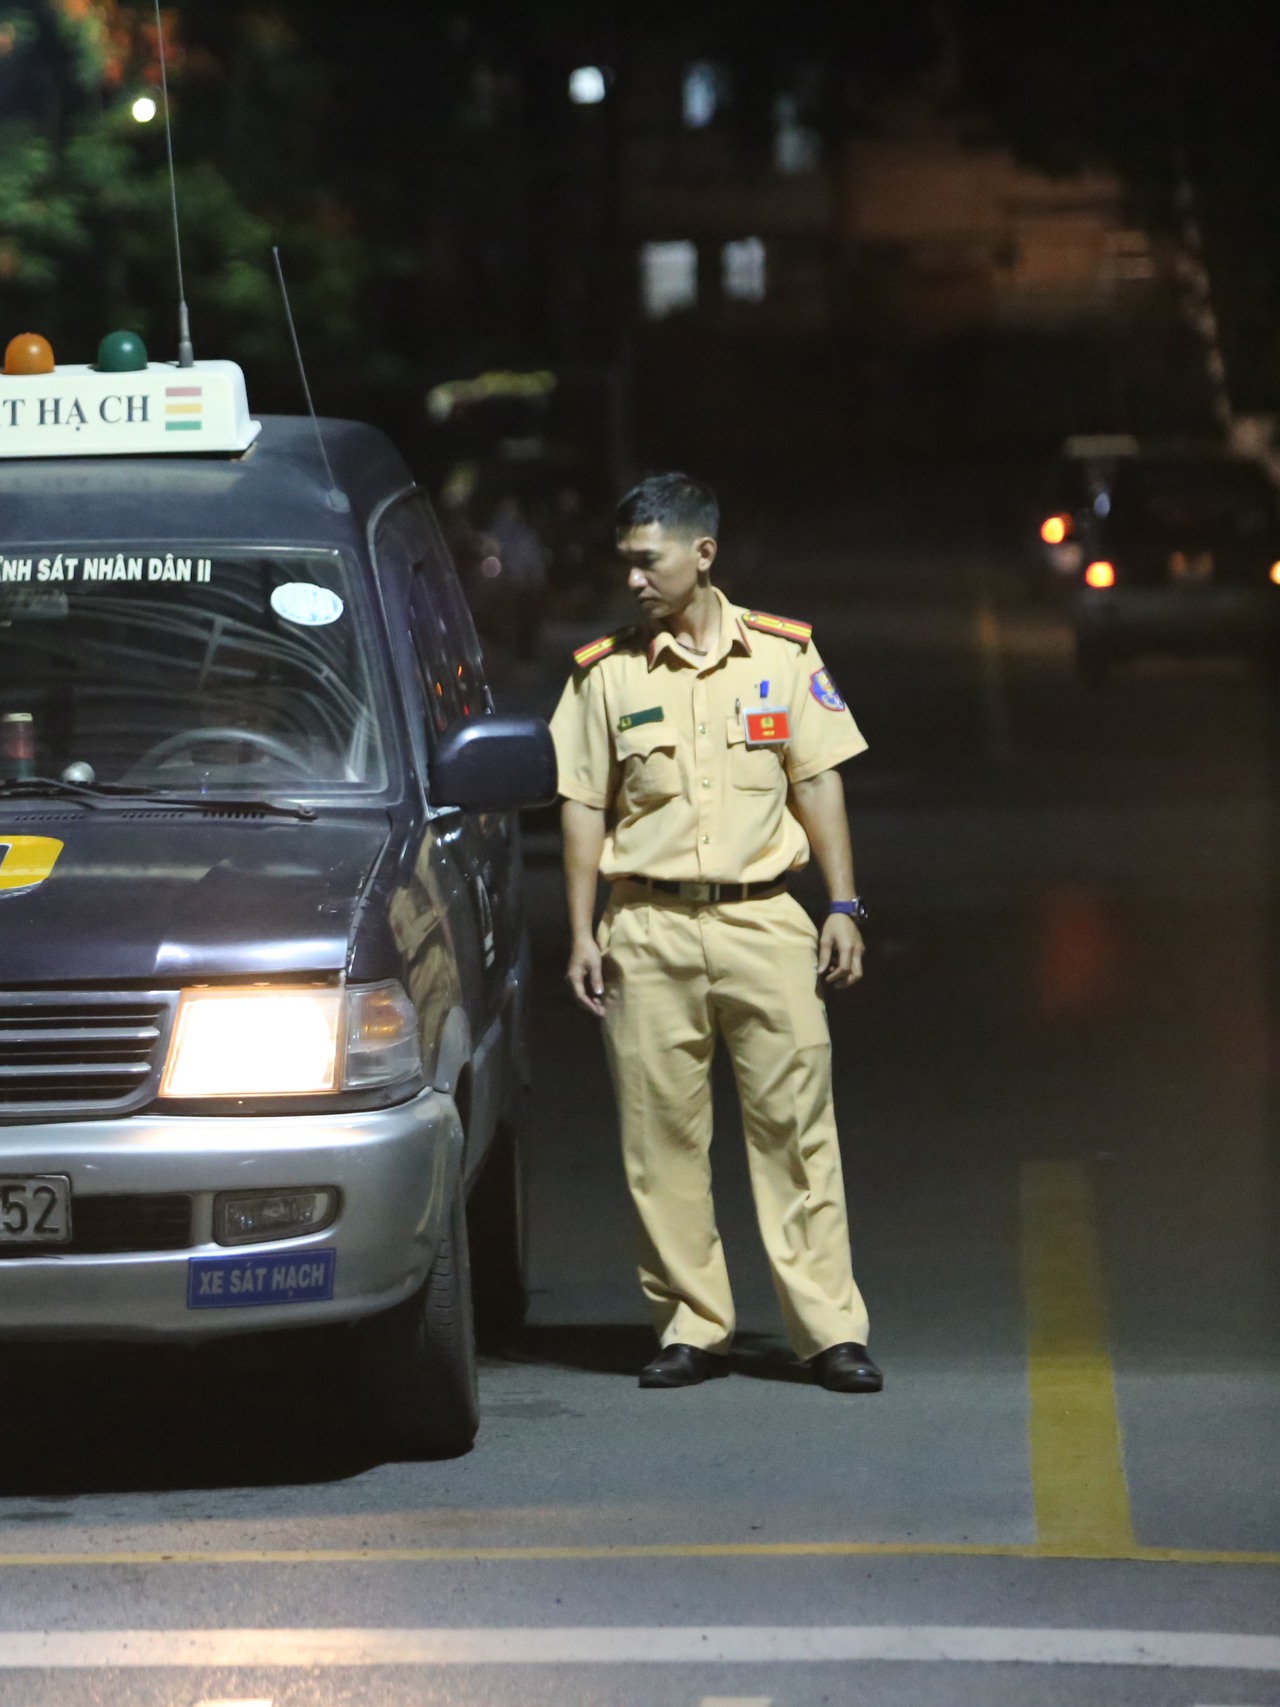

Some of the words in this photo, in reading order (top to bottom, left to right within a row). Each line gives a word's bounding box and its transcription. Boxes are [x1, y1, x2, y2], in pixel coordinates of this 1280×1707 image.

[37, 554, 78, 581] SÁT
[83, 553, 142, 580] NHÂN
[148, 553, 192, 582] DÂN
[197, 559, 211, 582] II
[200, 1271, 224, 1294] XE
[230, 1262, 267, 1293] SÁT
[272, 1263, 324, 1297] HẠCH
